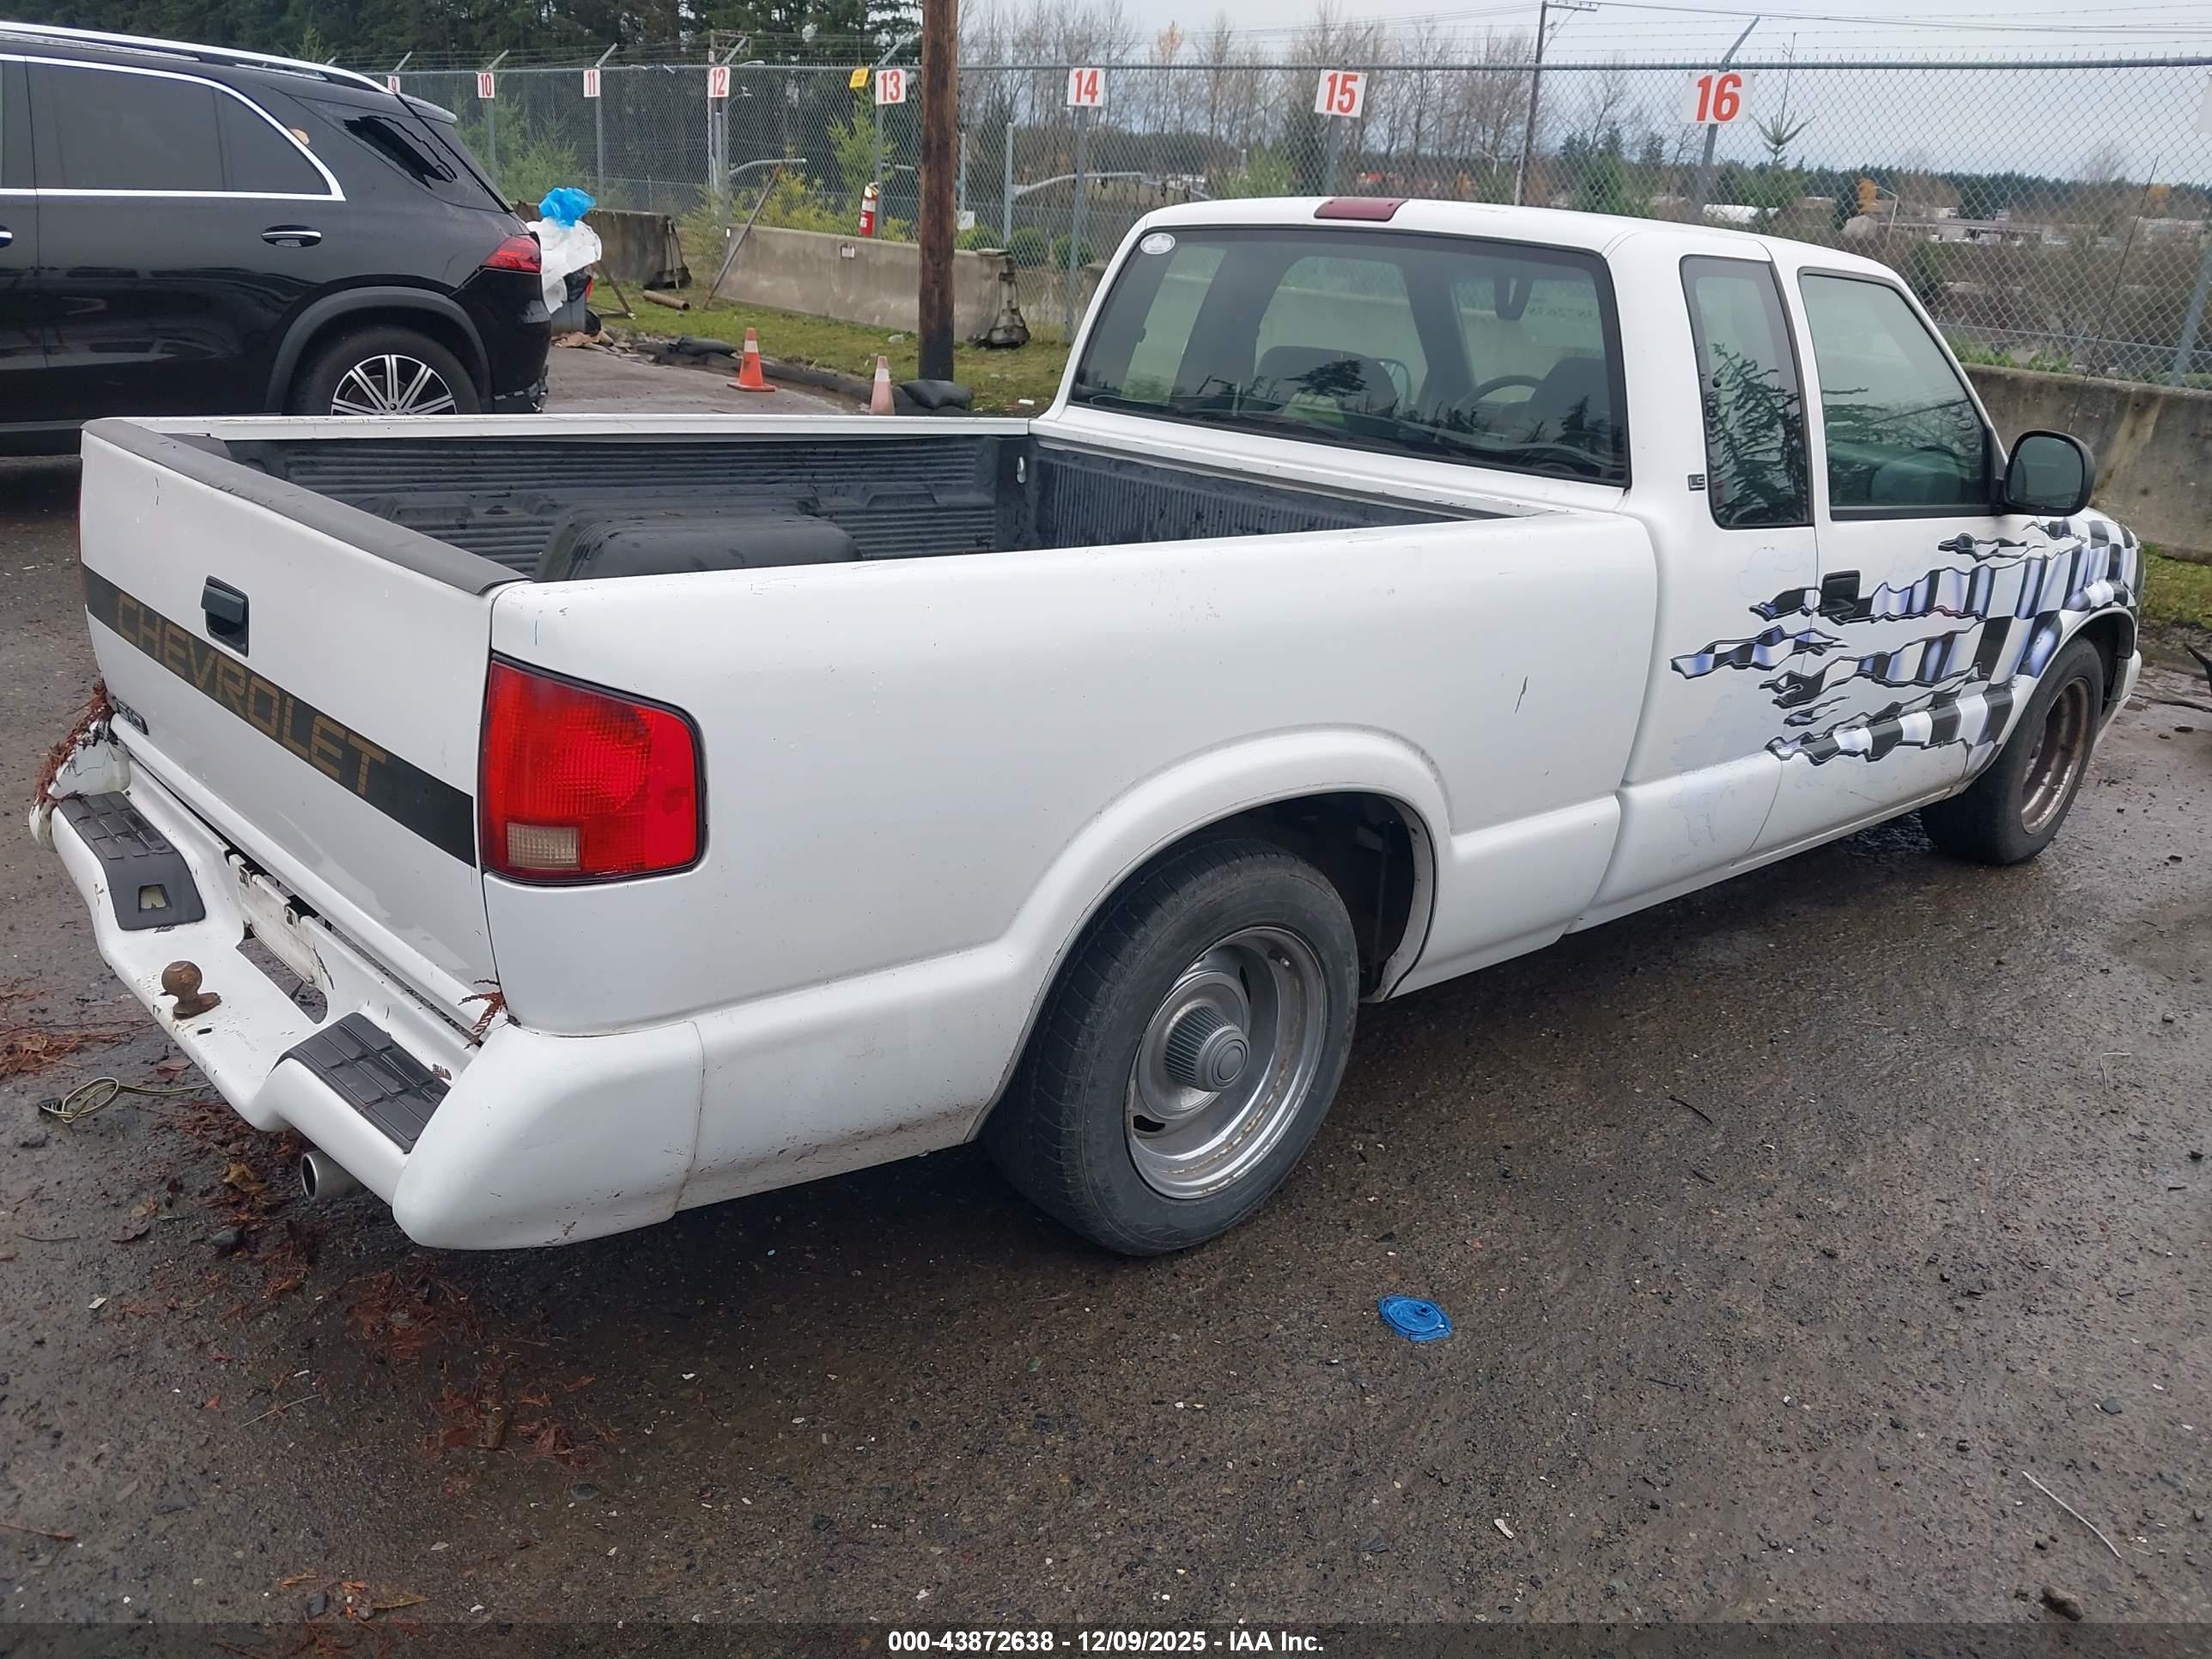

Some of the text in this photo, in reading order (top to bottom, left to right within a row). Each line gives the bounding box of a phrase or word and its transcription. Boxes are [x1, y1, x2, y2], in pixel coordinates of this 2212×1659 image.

[481, 74, 491, 96] 10
[587, 71, 596, 95] 11
[713, 69, 726, 95] 12
[881, 70, 901, 101] 13
[1075, 70, 1098, 103] 14
[1325, 73, 1358, 113] 15
[1697, 73, 1742, 121] 16
[118, 592, 386, 796] CHEVROLET
